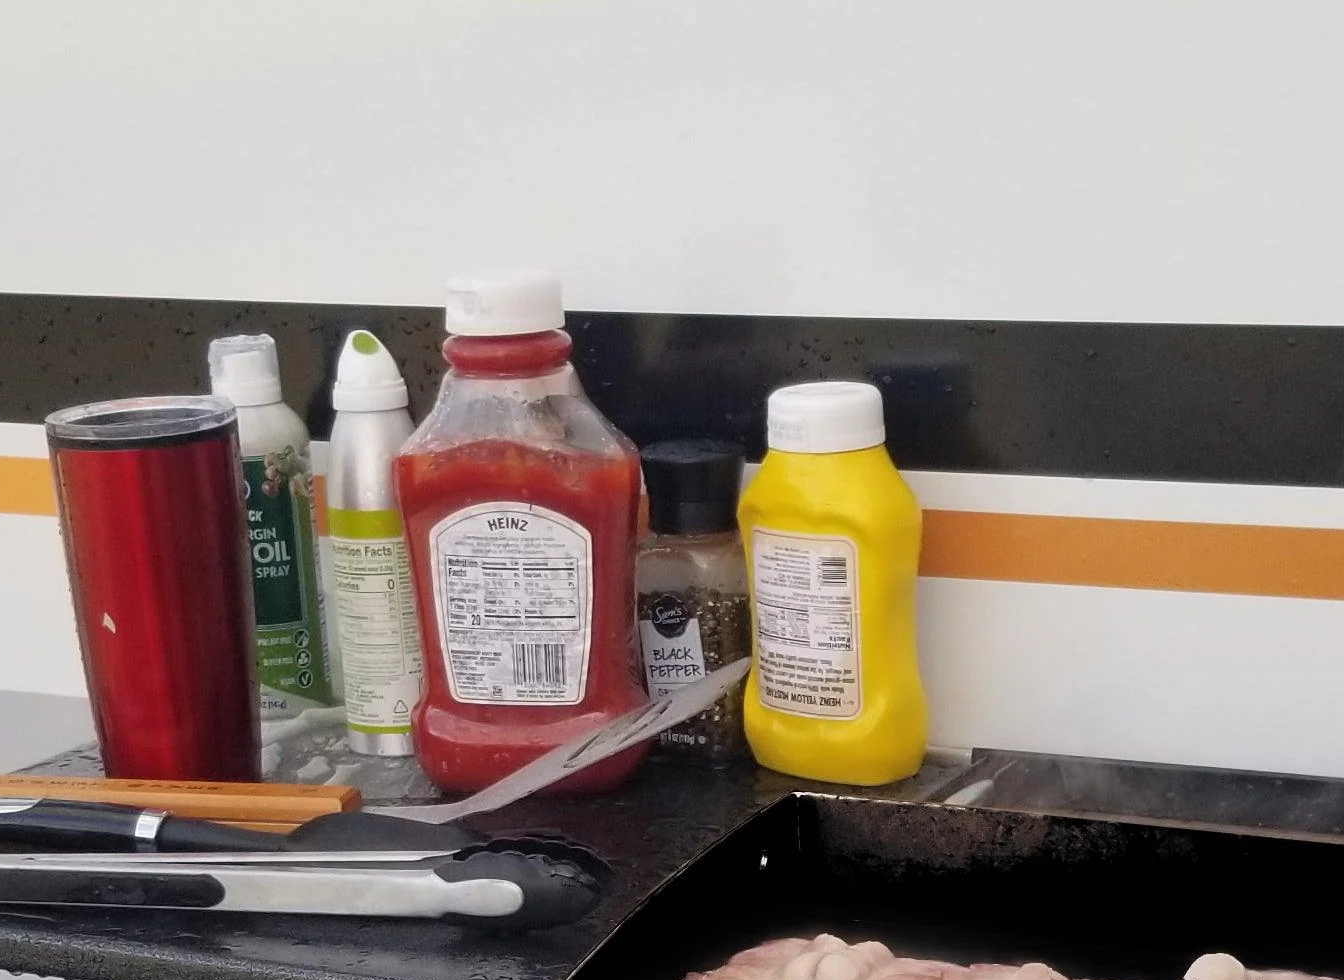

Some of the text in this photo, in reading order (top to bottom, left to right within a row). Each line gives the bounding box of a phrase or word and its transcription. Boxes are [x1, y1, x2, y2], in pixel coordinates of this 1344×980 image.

[487, 517, 529, 531] HEINZ
[253, 541, 291, 563] OIL
[364, 545, 393, 557] Facts
[256, 565, 290, 579] SPRAY
[387, 578, 395, 590] 0
[471, 614, 481, 626] 20
[654, 606, 682, 624] Sam's
[652, 647, 694, 662] BLACK
[648, 664, 702, 679] PEPPER
[790, 692, 818, 705] YELLOW
[819, 696, 841, 707] HEINZ
